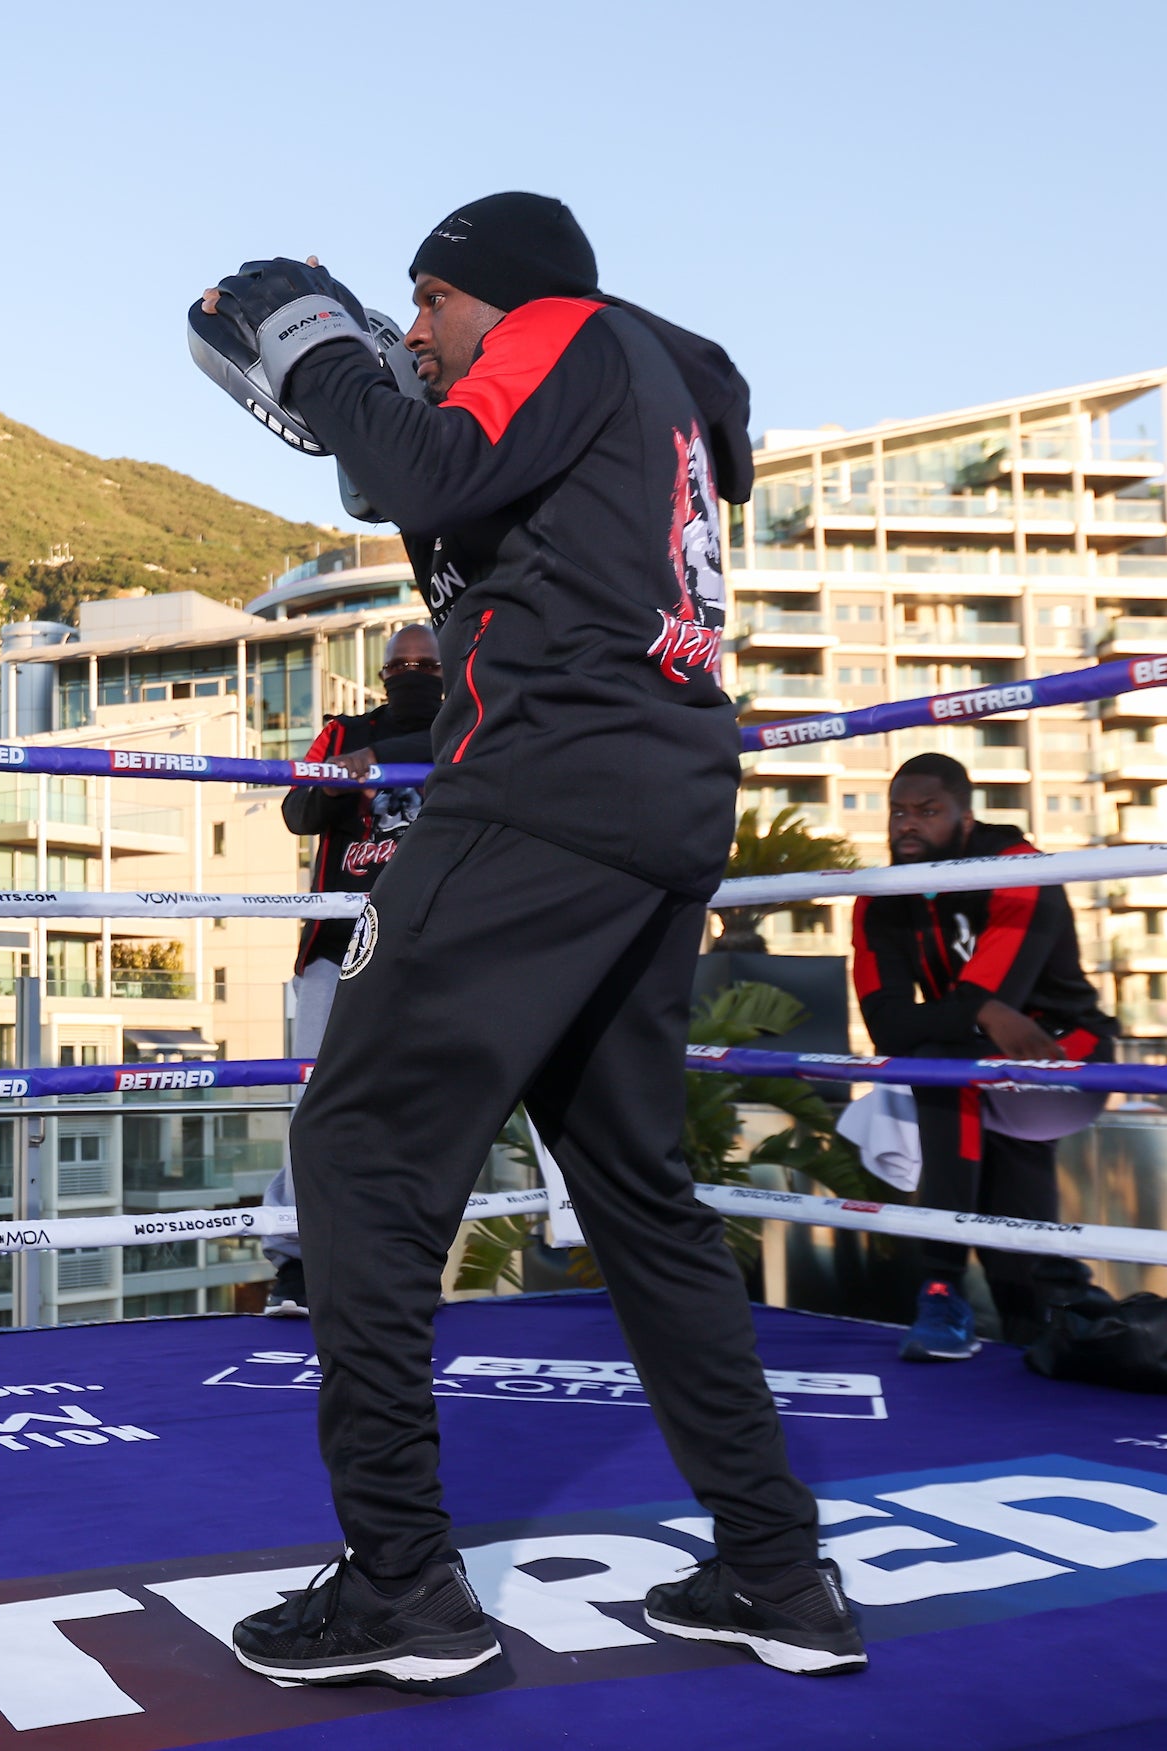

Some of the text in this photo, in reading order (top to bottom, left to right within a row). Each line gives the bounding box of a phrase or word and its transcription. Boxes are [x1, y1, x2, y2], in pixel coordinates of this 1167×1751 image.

[933, 685, 1033, 720] BETFRED
[761, 717, 846, 747] BETFRED
[113, 751, 208, 772] BETFRED
[136, 892, 178, 904] VOW
[118, 1070, 215, 1090] BETFRED
[134, 1216, 237, 1235] JDSPORTS.COM
[5, 1229, 51, 1246] VOW
